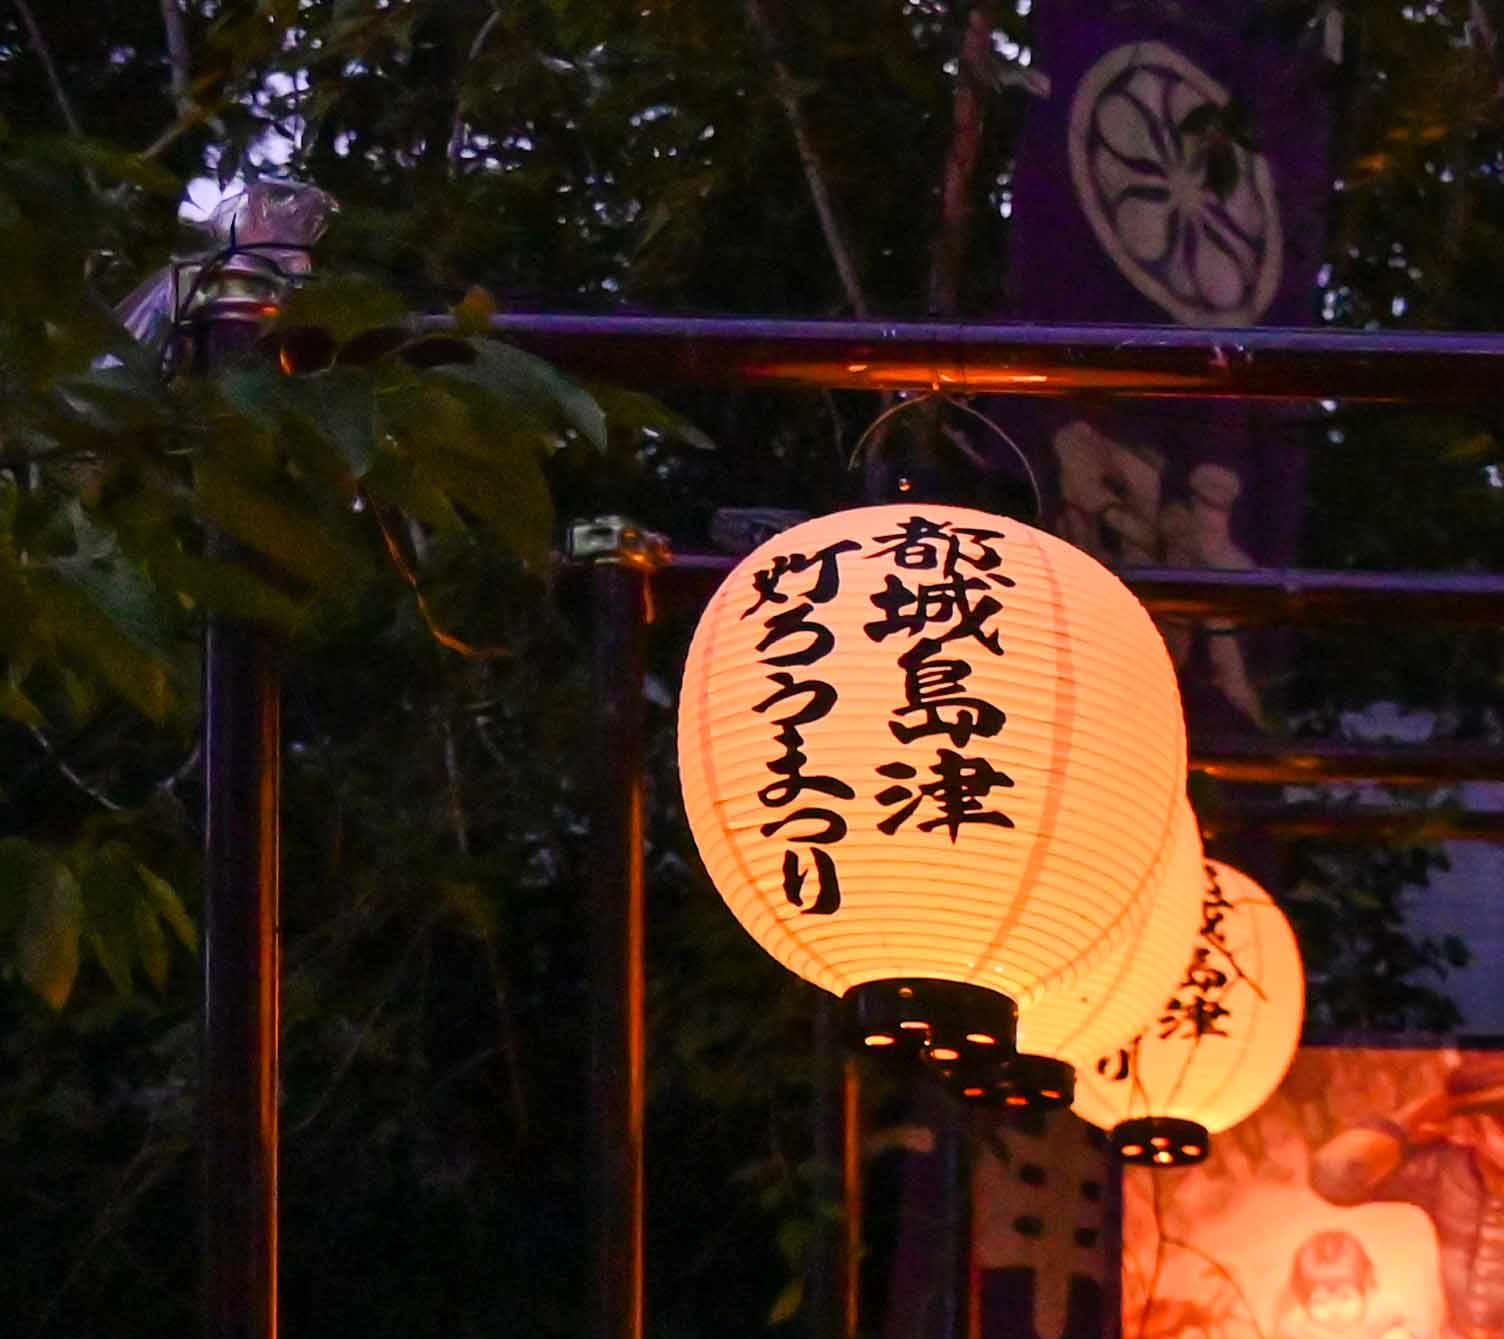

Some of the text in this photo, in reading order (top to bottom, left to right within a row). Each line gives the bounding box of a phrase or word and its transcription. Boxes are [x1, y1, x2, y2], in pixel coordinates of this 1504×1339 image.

[741, 539, 860, 915] 灯ろうまつり
[864, 516, 1015, 844] 都城島津
